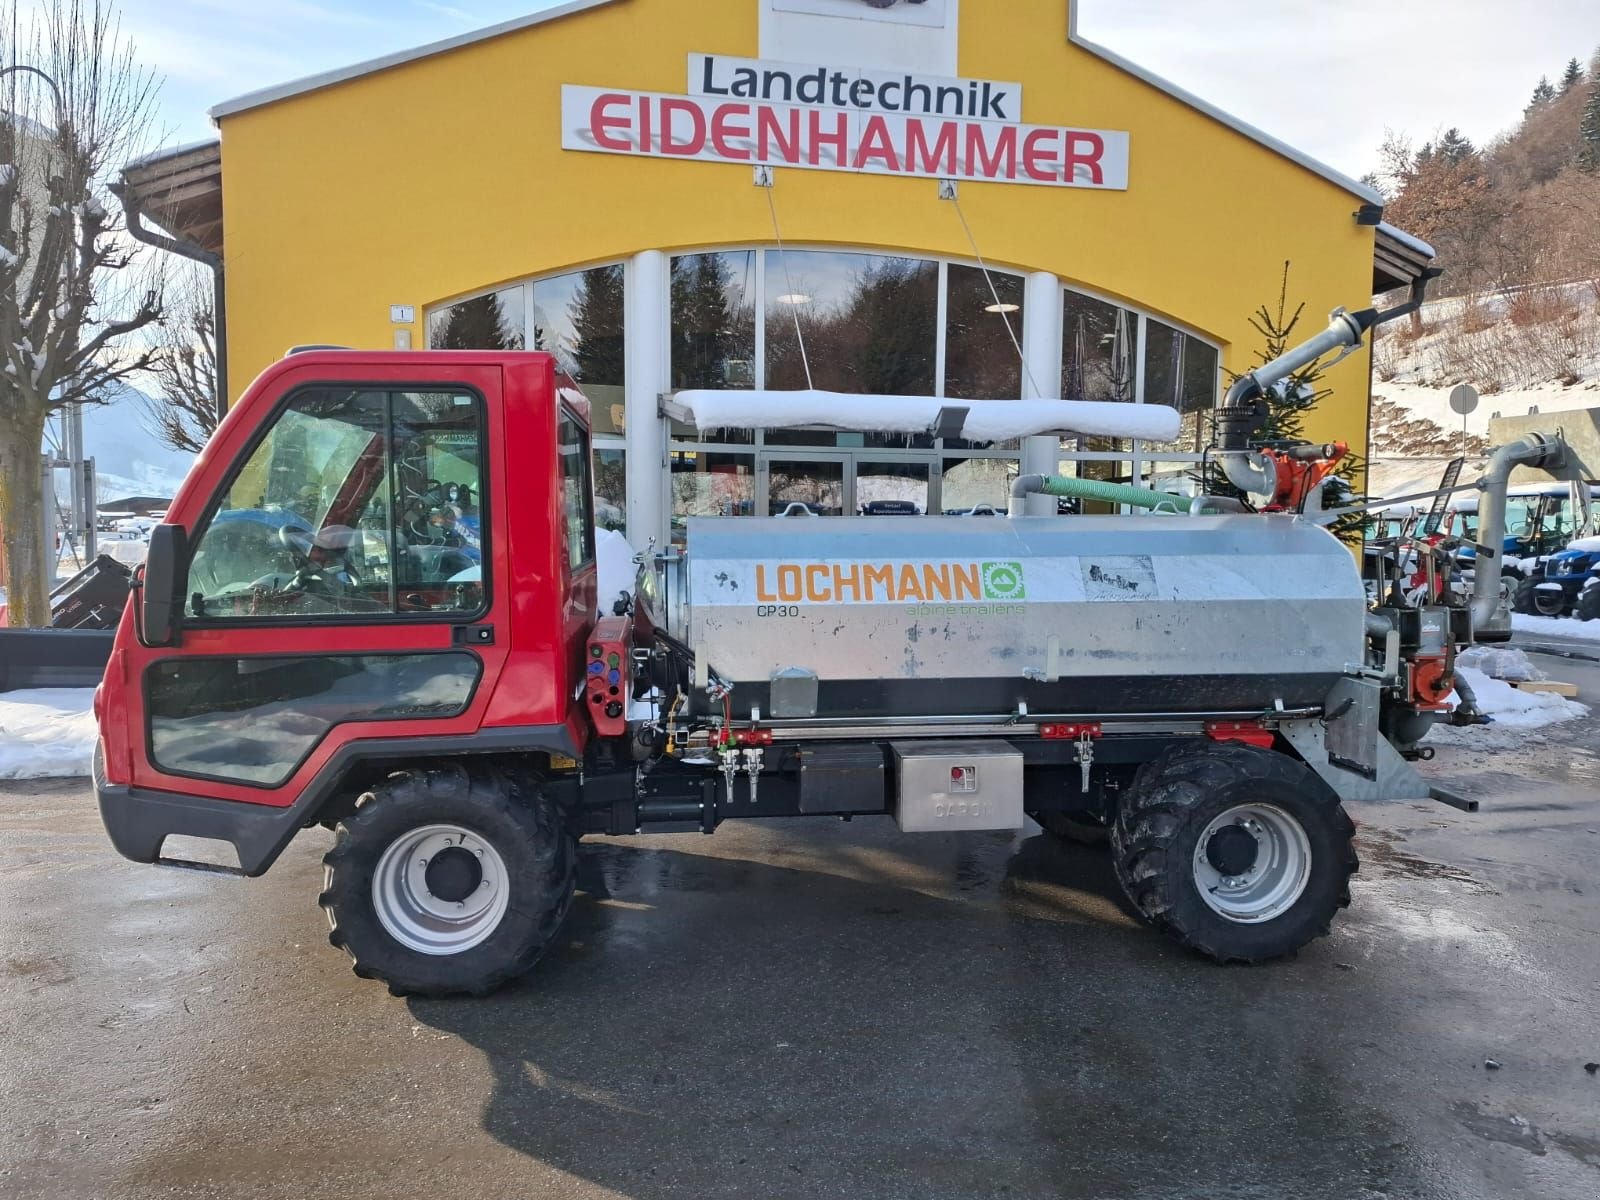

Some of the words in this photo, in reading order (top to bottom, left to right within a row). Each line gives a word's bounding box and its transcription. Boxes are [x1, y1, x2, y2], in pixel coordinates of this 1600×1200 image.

[704, 56, 1007, 118] Landtechnik
[590, 93, 1103, 185] EIDENHAMMER
[755, 564, 981, 602] LOCHMANN
[757, 605, 799, 617] CP30
[907, 605, 956, 616] alpine
[960, 603, 1025, 615] trailers
